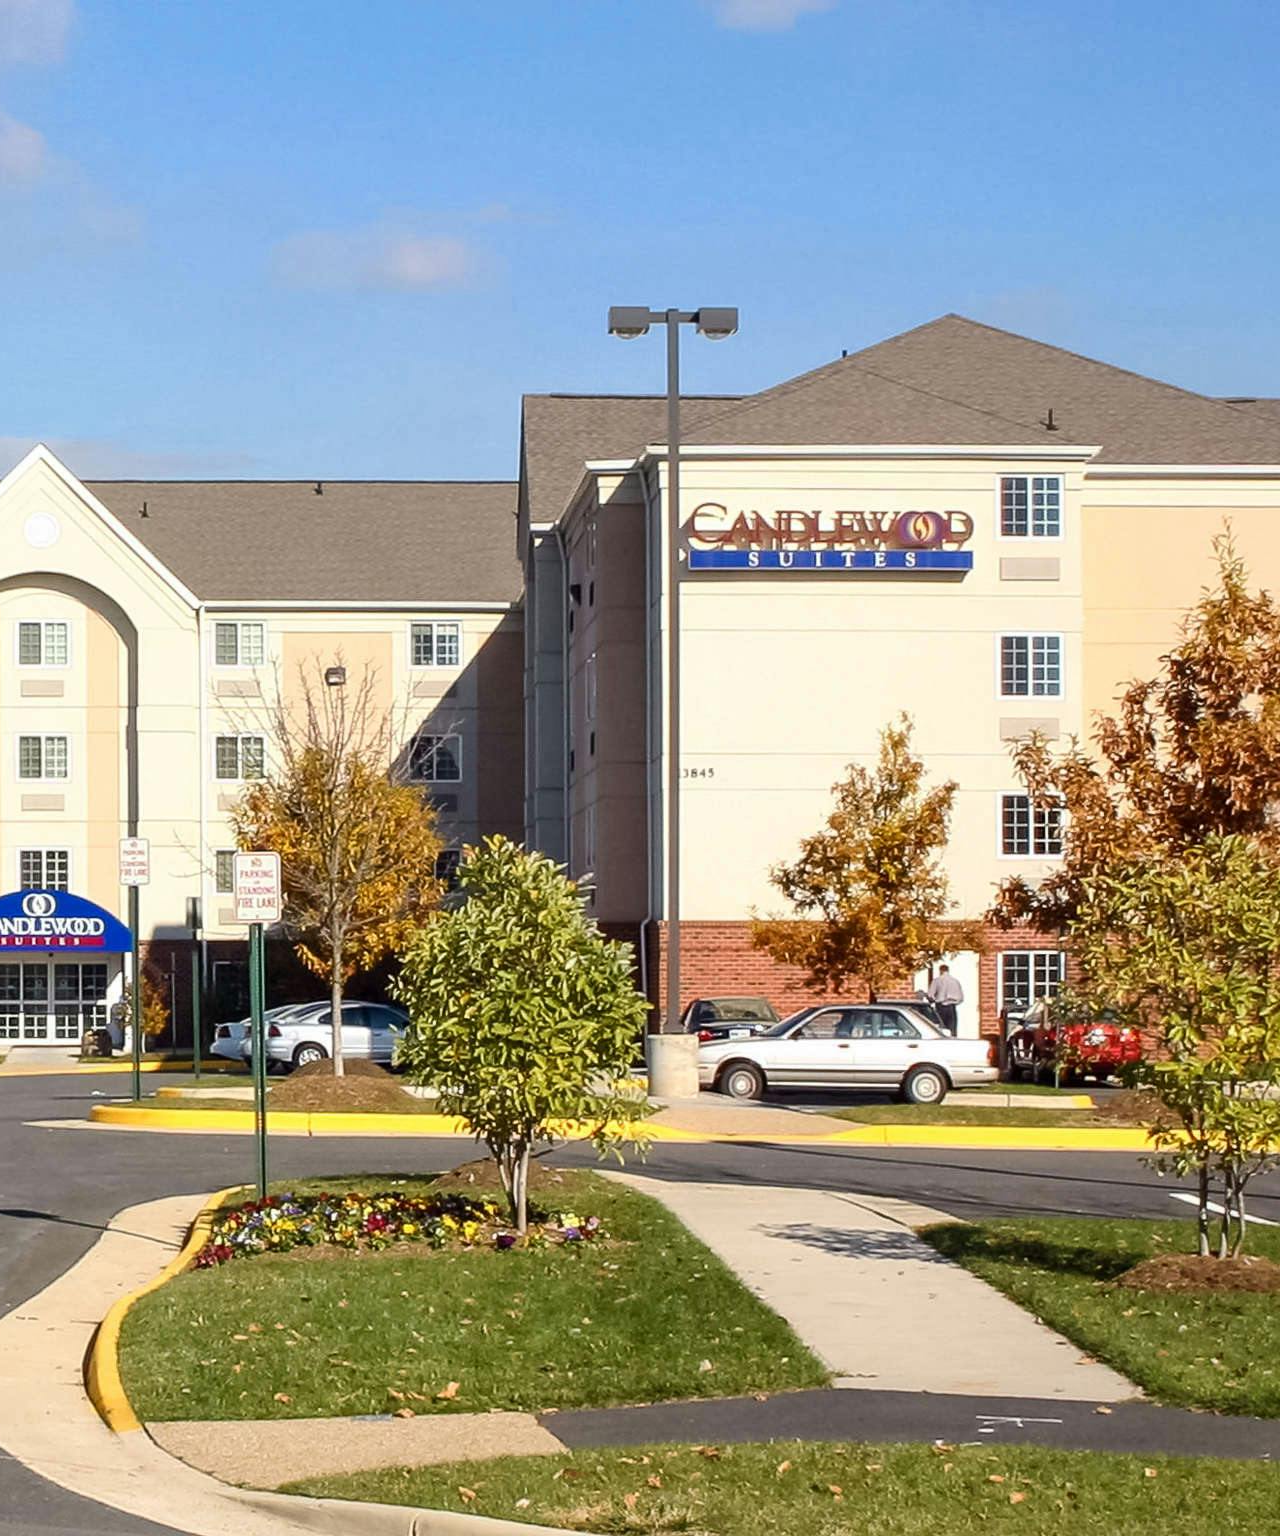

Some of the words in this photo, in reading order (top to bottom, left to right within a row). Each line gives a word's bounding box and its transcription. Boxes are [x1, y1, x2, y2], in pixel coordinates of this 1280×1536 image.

[689, 502, 974, 545] CANDLEWOOD
[748, 551, 917, 567] SUITES
[1, 936, 81, 946] SUITES
